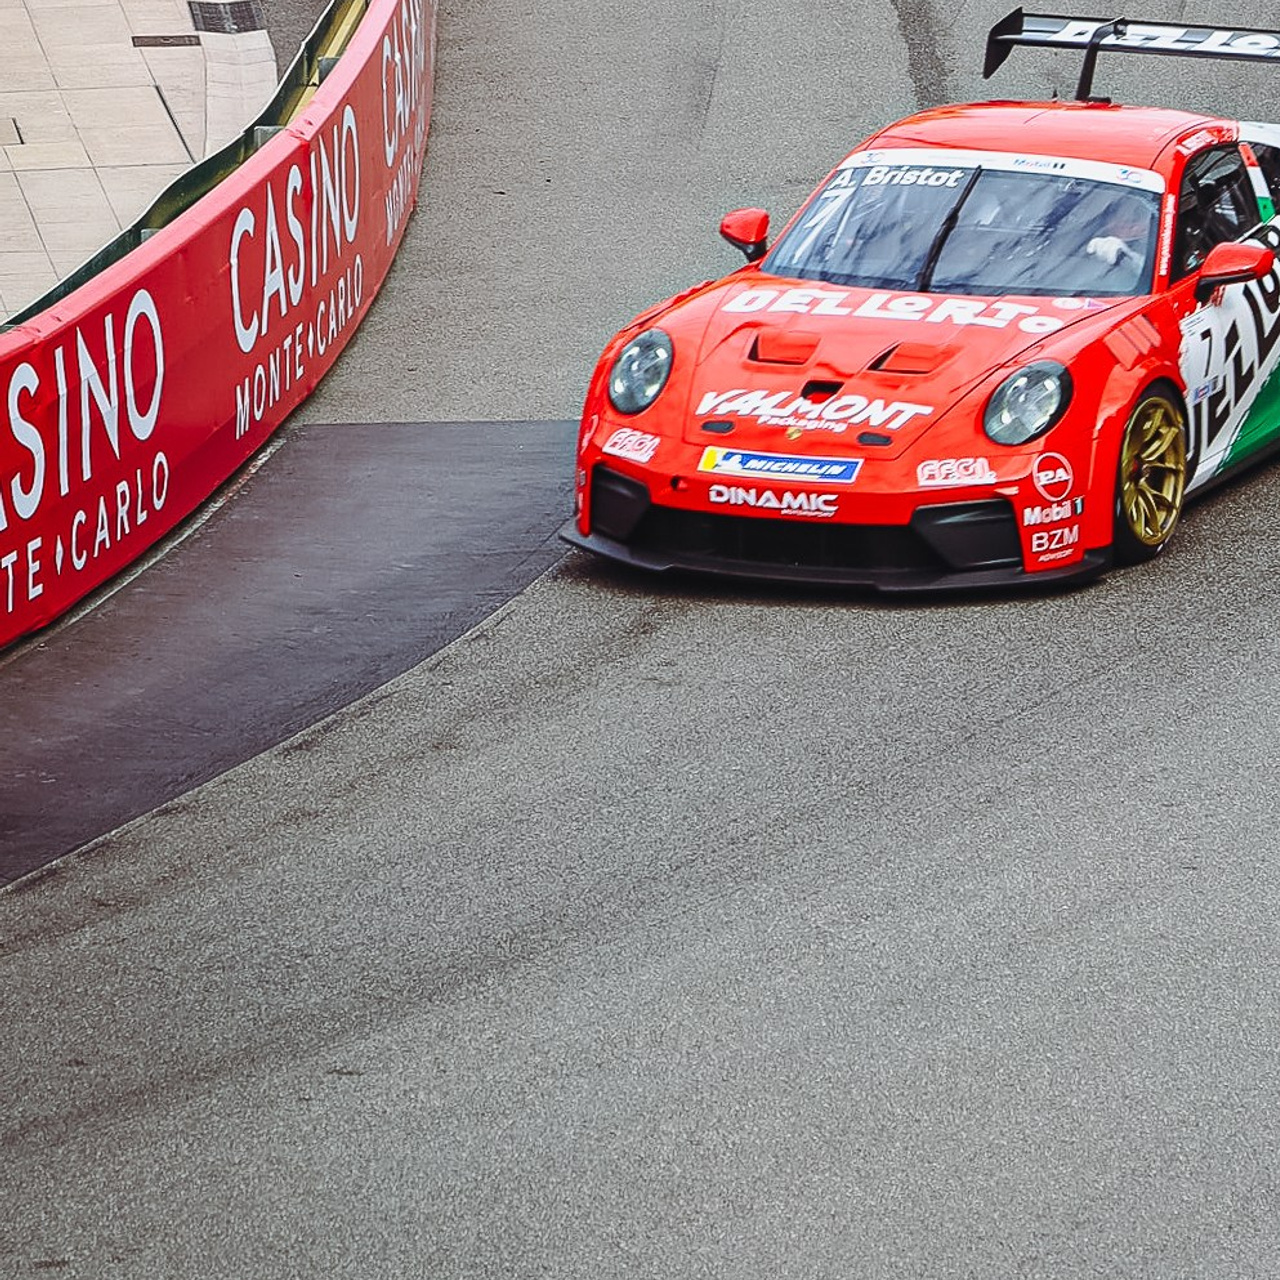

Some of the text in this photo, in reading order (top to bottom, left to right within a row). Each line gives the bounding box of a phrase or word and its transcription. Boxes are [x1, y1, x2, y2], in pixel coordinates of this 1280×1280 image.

[828, 166, 965, 190] A. Bristot
[229, 104, 360, 353] CASINO
[0, 289, 164, 529] SINO
[695, 389, 935, 430] VALMONT
[756, 415, 848, 432] Packaging
[742, 458, 848, 476] MICHELIN
[709, 484, 839, 512] DINAMIC
[1023, 496, 1084, 526] Mobil 1
[1032, 524, 1079, 552] BZM
